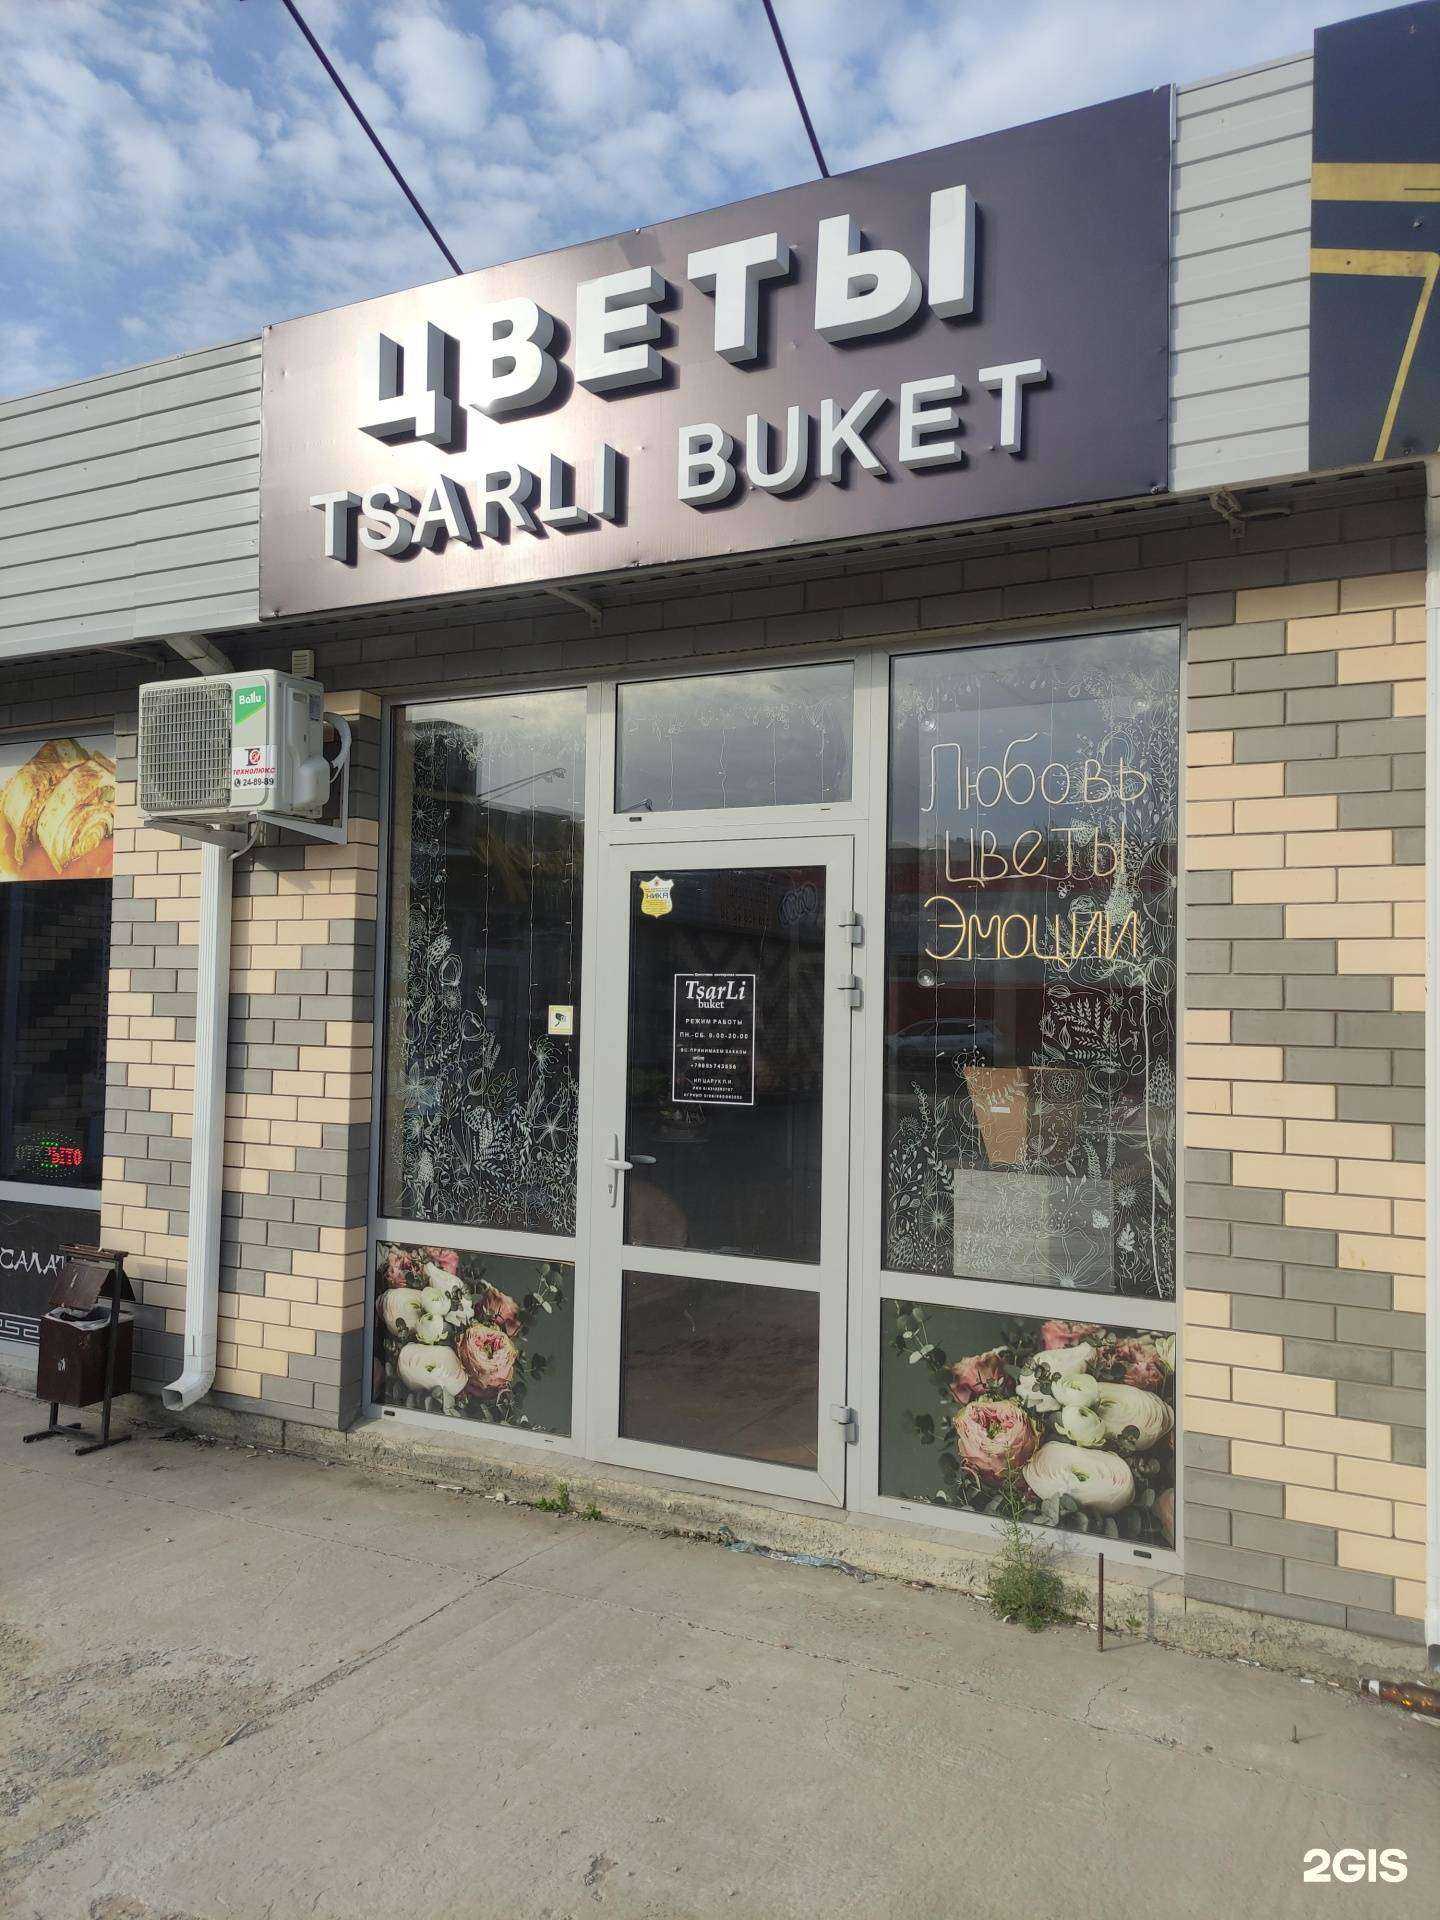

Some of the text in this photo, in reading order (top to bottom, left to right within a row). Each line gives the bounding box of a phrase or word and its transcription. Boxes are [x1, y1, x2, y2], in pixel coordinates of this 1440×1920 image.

[358, 184, 976, 446] ЦВЕТЫ
[310, 358, 1047, 562] TSARLI BUKET
[239, 690, 262, 705] Ballu
[920, 732, 1148, 812] Любовь
[923, 895, 1141, 968] Эмоции
[685, 980, 747, 1000] TsarLi
[698, 998, 725, 1009] buket
